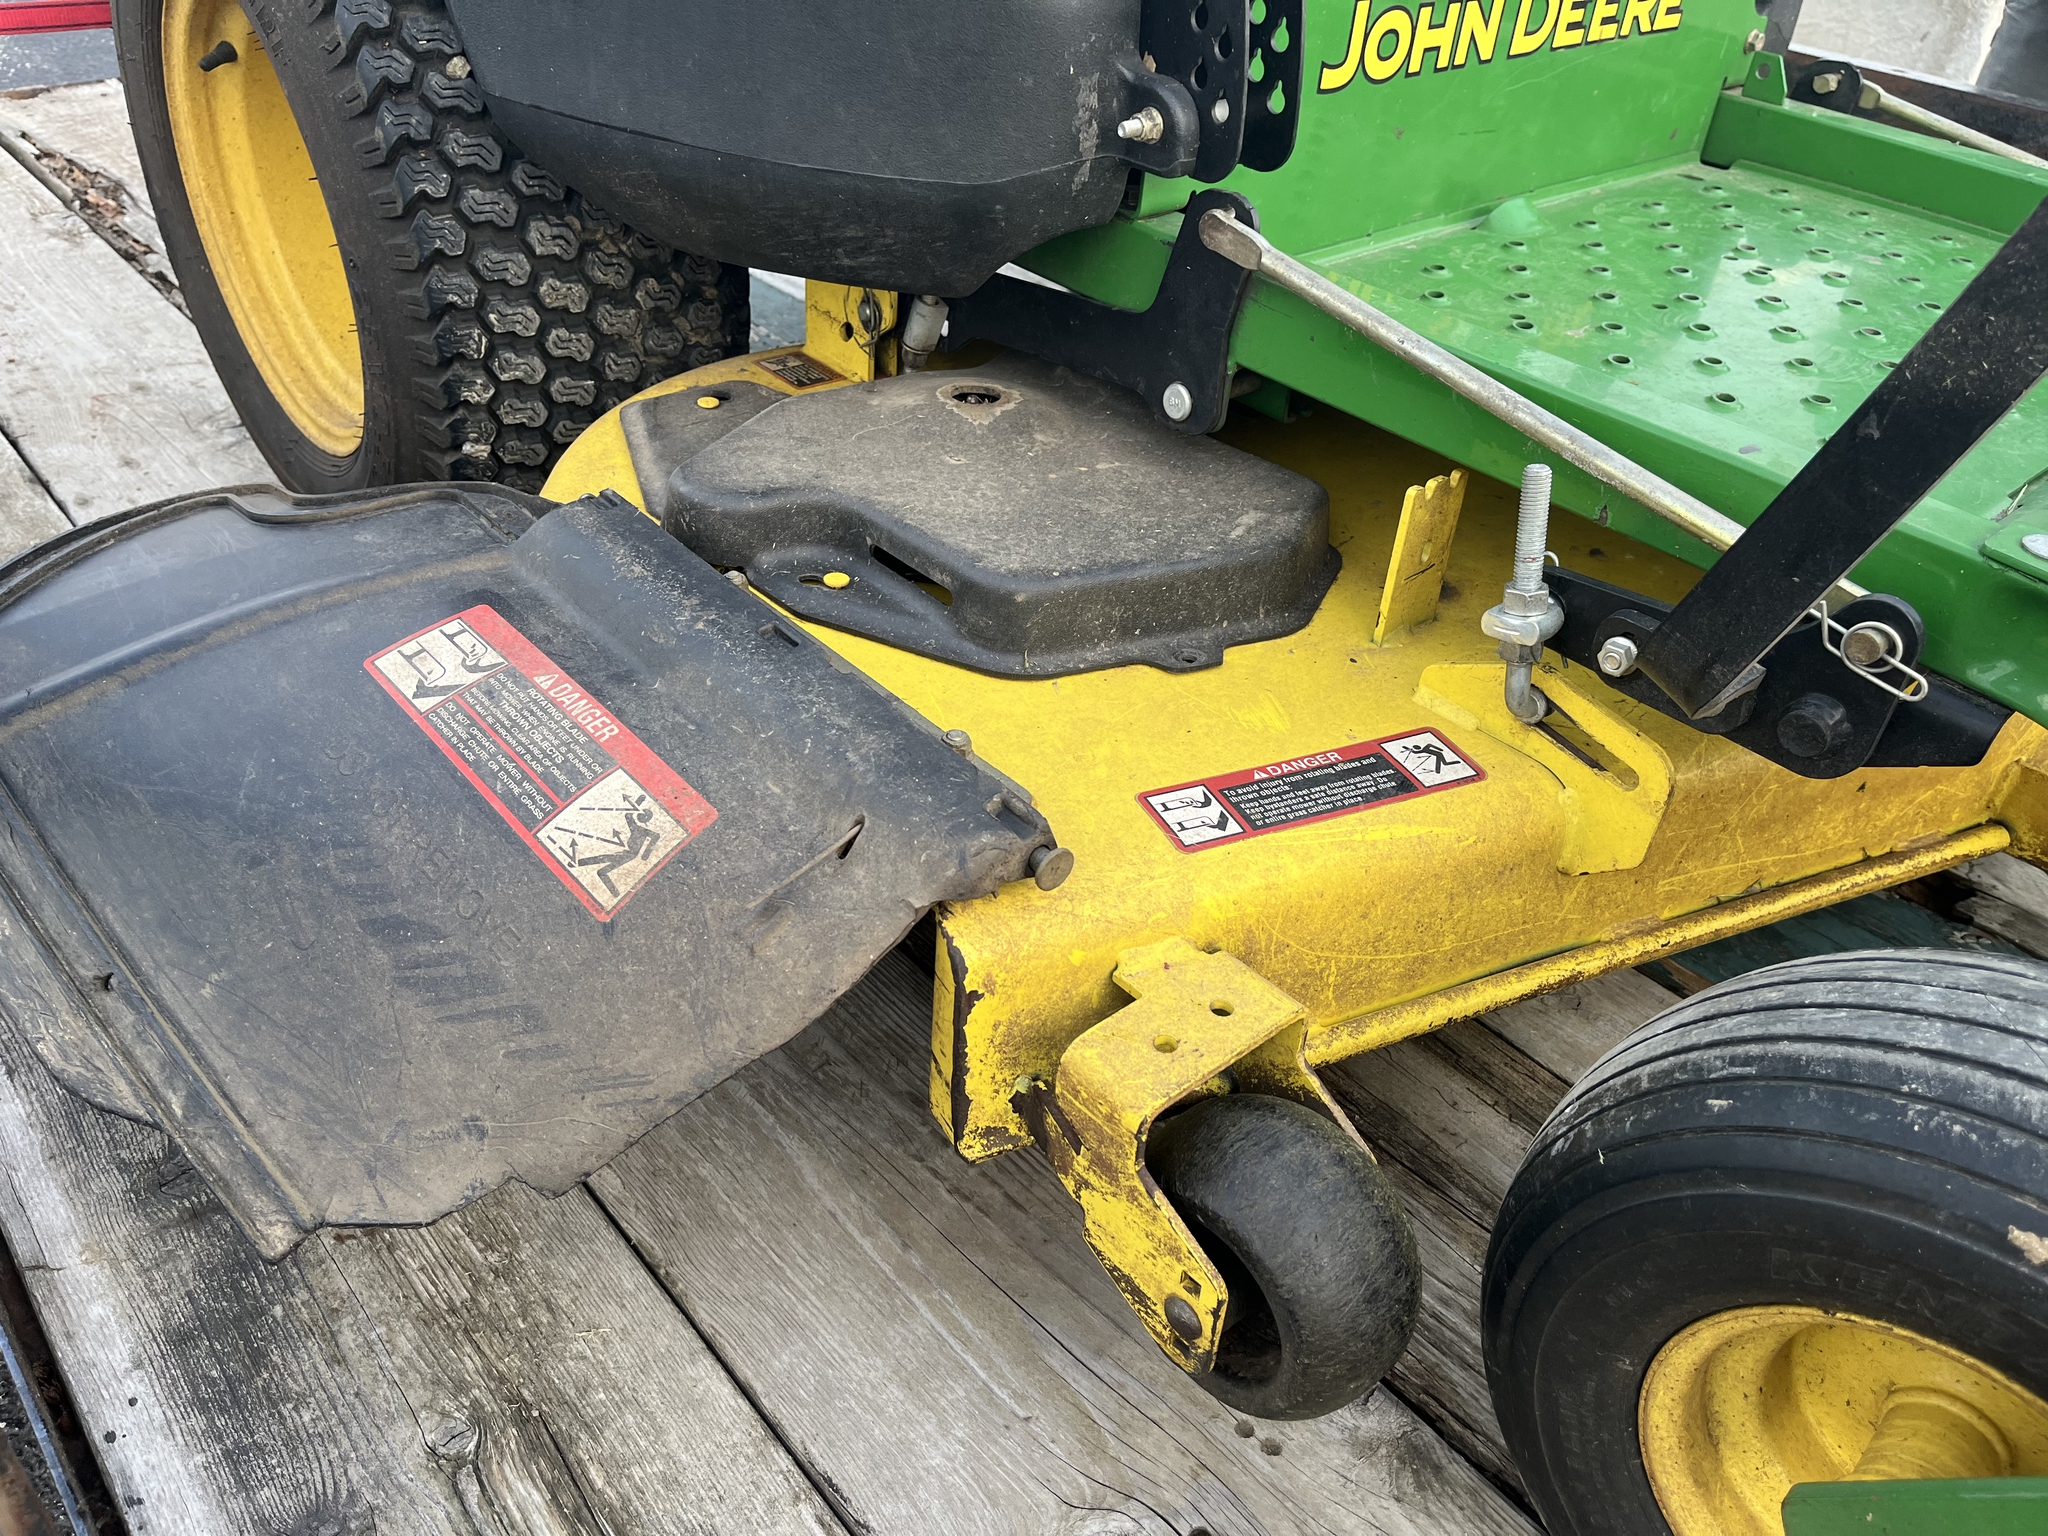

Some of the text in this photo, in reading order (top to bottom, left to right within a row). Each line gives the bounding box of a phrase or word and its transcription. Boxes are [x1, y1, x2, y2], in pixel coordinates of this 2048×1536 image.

[1317, 0, 1683, 94] JOHN DEERE
[427, 712, 476, 762] CATCHER IN PLACE
[461, 690, 545, 774] THAT MAY BE THROWN BY BLADE
[469, 686, 492, 707] BEFORE
[510, 726, 531, 745] CLEAR
[526, 743, 543, 759] AREA
[541, 757, 553, 767] OF
[549, 765, 577, 793] OBJECTS
[487, 676, 594, 780] INTO MOWER WHEN ENGINE IS RUNNING
[495, 672, 603, 775] DO NOT PUT HANDS OR FEET UNDER OR
[498, 698, 564, 764] THROWN OBJECTS
[525, 687, 589, 744] ROTATING BLADE
[547, 687, 618, 743] DANGER
[435, 706, 544, 820] DISCHARGE CHUTE OR ENTIRE GRASS
[444, 701, 553, 812] DO NOT OPERATE MOWER WITHOUT
[1236, 783, 1260, 793] avoid
[1303, 767, 1336, 778] rotating
[1333, 760, 1361, 770] blades
[1361, 756, 1376, 764] and
[1268, 751, 1343, 776] DANGER
[1229, 784, 1293, 802] thrown objects:
[1239, 801, 1260, 809] Keep
[1258, 795, 1281, 804] hands
[1345, 774, 1373, 784] rotating
[1370, 768, 1397, 777] blades.
[1263, 806, 1292, 816] operate
[1291, 800, 1316, 809] mower
[1316, 793, 1344, 803] without
[1343, 785, 1378, 798] discharge
[1377, 781, 1397, 789] chute
[1264, 796, 1304, 809] bystanders
[1326, 784, 1356, 794] distance
[1265, 814, 1287, 822] entire
[1287, 809, 1308, 818] grass
[1307, 802, 1334, 812] catcher
[1343, 795, 1366, 805] place.
